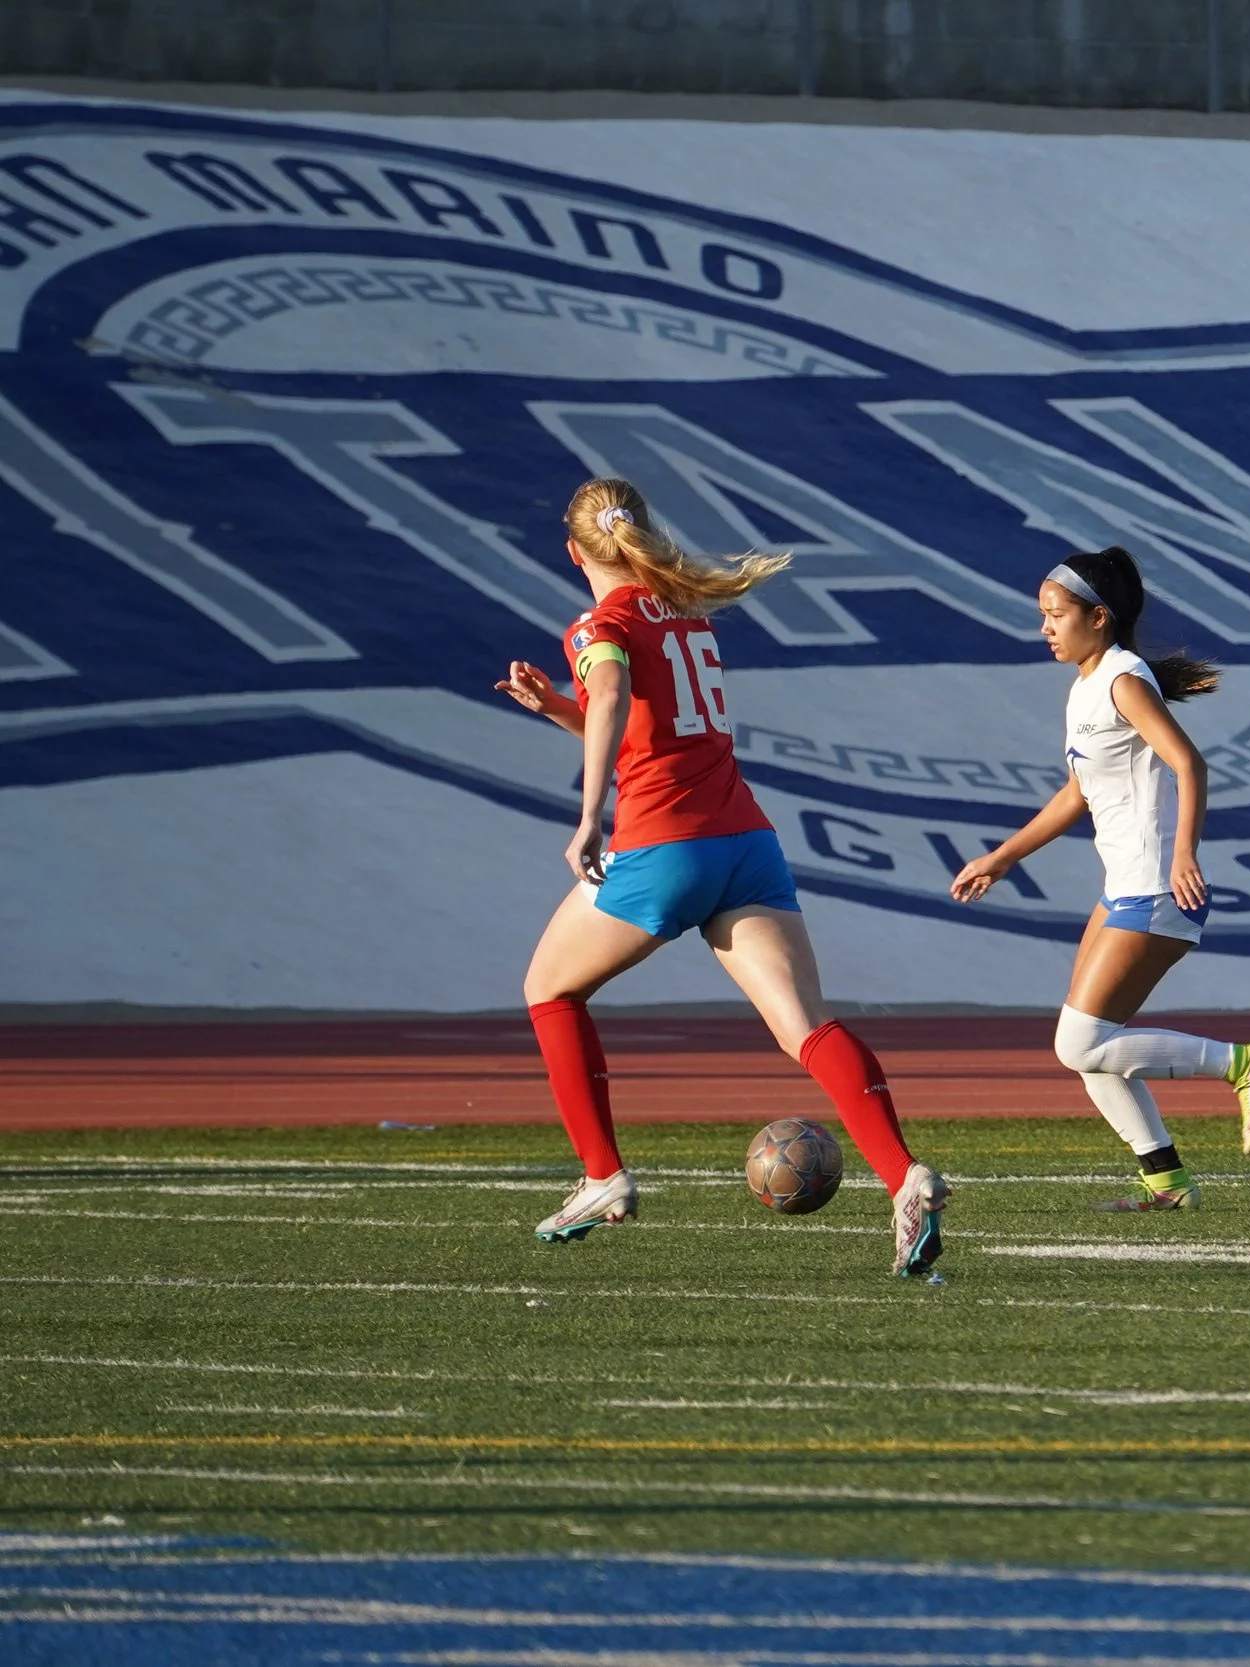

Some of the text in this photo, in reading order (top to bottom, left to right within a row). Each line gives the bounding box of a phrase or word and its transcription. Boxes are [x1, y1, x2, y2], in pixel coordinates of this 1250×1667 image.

[0, 151, 784, 301] AN MARINO
[661, 631, 732, 737] 16
